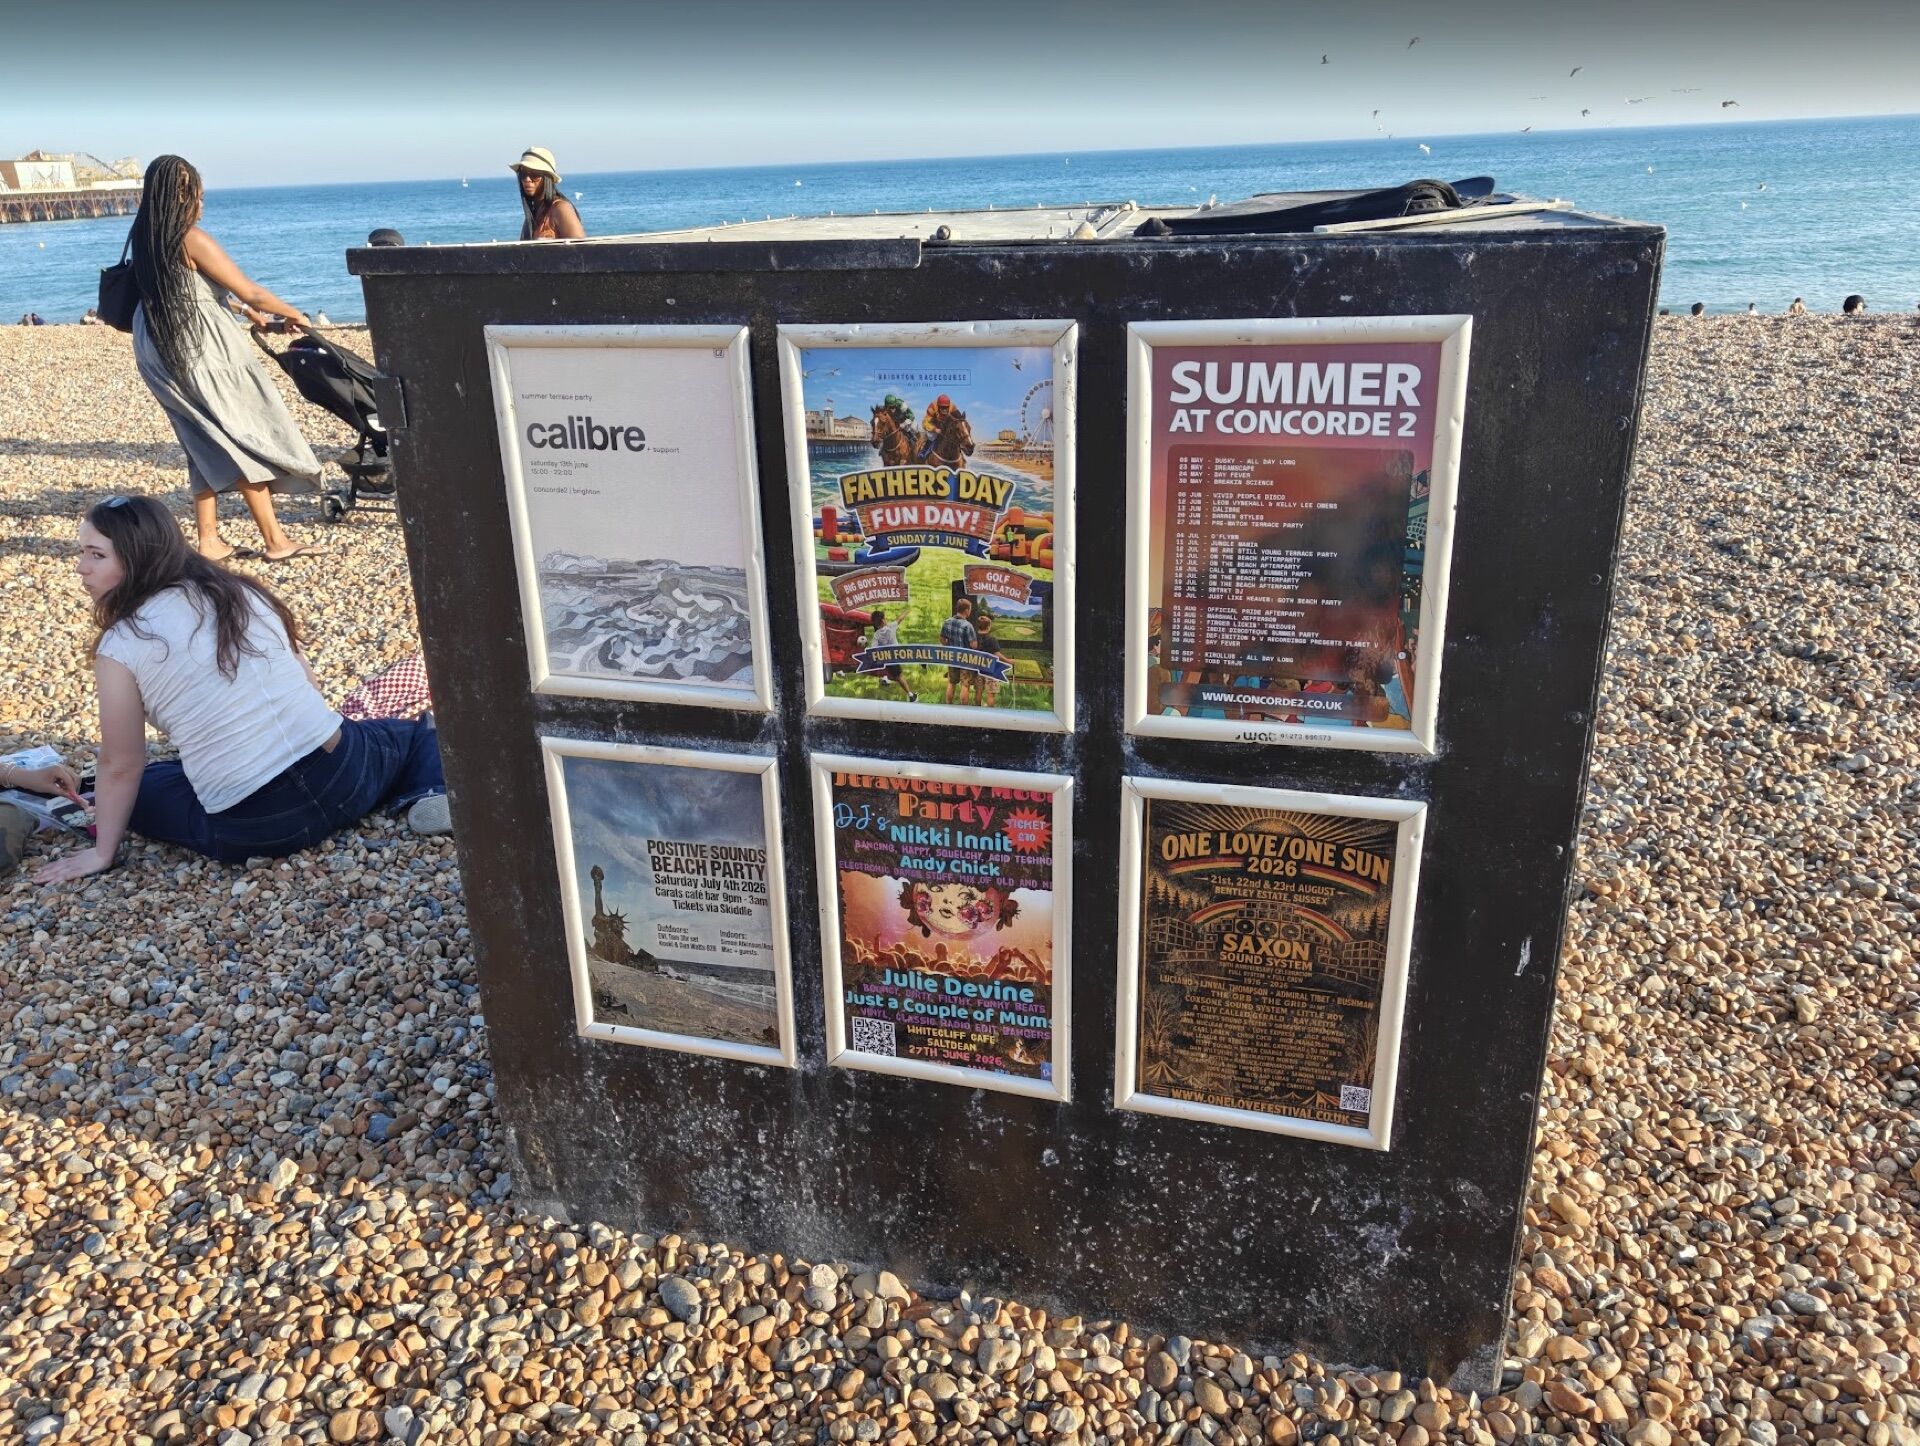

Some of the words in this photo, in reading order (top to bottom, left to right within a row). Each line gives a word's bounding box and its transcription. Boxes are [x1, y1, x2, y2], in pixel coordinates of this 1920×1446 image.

[1170, 361, 1422, 406] SUMMER
[1169, 409, 1211, 433] AT
[1216, 409, 1391, 436] CONCORDE
[1398, 413, 1417, 437] 2
[527, 416, 645, 451] calibre
[843, 470, 950, 504] FATHERS
[960, 471, 1011, 505] DAY
[870, 506, 918, 530] FUN
[924, 506, 980, 531] DAY!
[887, 535, 926, 545] SUNDAY
[929, 535, 940, 544] 21
[943, 536, 968, 548] JUNE
[844, 582, 856, 594] BIG
[857, 578, 876, 590] BOYS
[878, 575, 897, 586] TOYS
[986, 572, 1010, 583] GOLF
[853, 589, 900, 604] INFLATABLES
[973, 583, 1021, 598] SIMULATOR
[872, 650, 892, 661] FUN
[894, 649, 913, 660] FOR
[915, 649, 933, 659] ALL
[934, 650, 953, 661] THE
[956, 652, 993, 668] FAMILY
[1202, 692, 1342, 711] WWW.CONCORDE2.CO.UK
[899, 793, 997, 831] Party
[1008, 819, 1046, 831] TICKET
[890, 825, 950, 847] Nikki
[957, 831, 1013, 852] Innit
[647, 840, 708, 858] POSITIVE
[711, 846, 766, 864] SOUNDS
[989, 853, 1010, 863] ACID
[1162, 832, 1212, 861] ONE
[1219, 832, 1337, 867] LOVE/ONE
[1341, 847, 1390, 885] SUN
[651, 856, 707, 876] BEACH
[711, 860, 766, 881] PARTY
[900, 856, 946, 873] Andy
[950, 859, 999, 876] Chick
[1248, 857, 1297, 877] 2026
[655, 874, 698, 888] Saturday
[701, 878, 720, 890] July
[723, 880, 740, 891] 4th
[742, 881, 766, 893] 2026
[1211, 875, 1234, 887] 21st,
[1236, 877, 1261, 888] 22nd
[1263, 880, 1272, 889] &
[1273, 881, 1296, 892] 23rd
[1298, 884, 1336, 896] AUGUST
[705, 891, 719, 901] bar
[723, 893, 742, 904] 9pm
[1215, 886, 1254, 897] BENTLEY
[1293, 894, 1328, 906] SUSSEX
[672, 899, 703, 912] Tickets
[706, 902, 718, 913] via
[720, 903, 752, 916] Skiddle
[1223, 934, 1311, 962] SAXON
[1219, 952, 1263, 966] SOUND
[1266, 955, 1313, 971] SYSTEM
[881, 969, 938, 992] Julie
[944, 977, 1034, 1003] Devine
[846, 991, 884, 1006] Just
[888, 998, 899, 1009] a
[903, 999, 970, 1023] Couple
[973, 1009, 995, 1022] of
[1015, 1003, 1046, 1014] BEATS
[941, 1019, 971, 1030] RADIO
[907, 1025, 966, 1040] WHITECLIFF
[971, 1033, 996, 1044] CAFE
[909, 1045, 939, 1058] 27TH
[942, 1050, 970, 1061] JUNE
[927, 1038, 977, 1051] SALTDEAN
[1171, 1089, 1350, 1125] WWW.ONELOVEFESTIVAL.CO.UK
